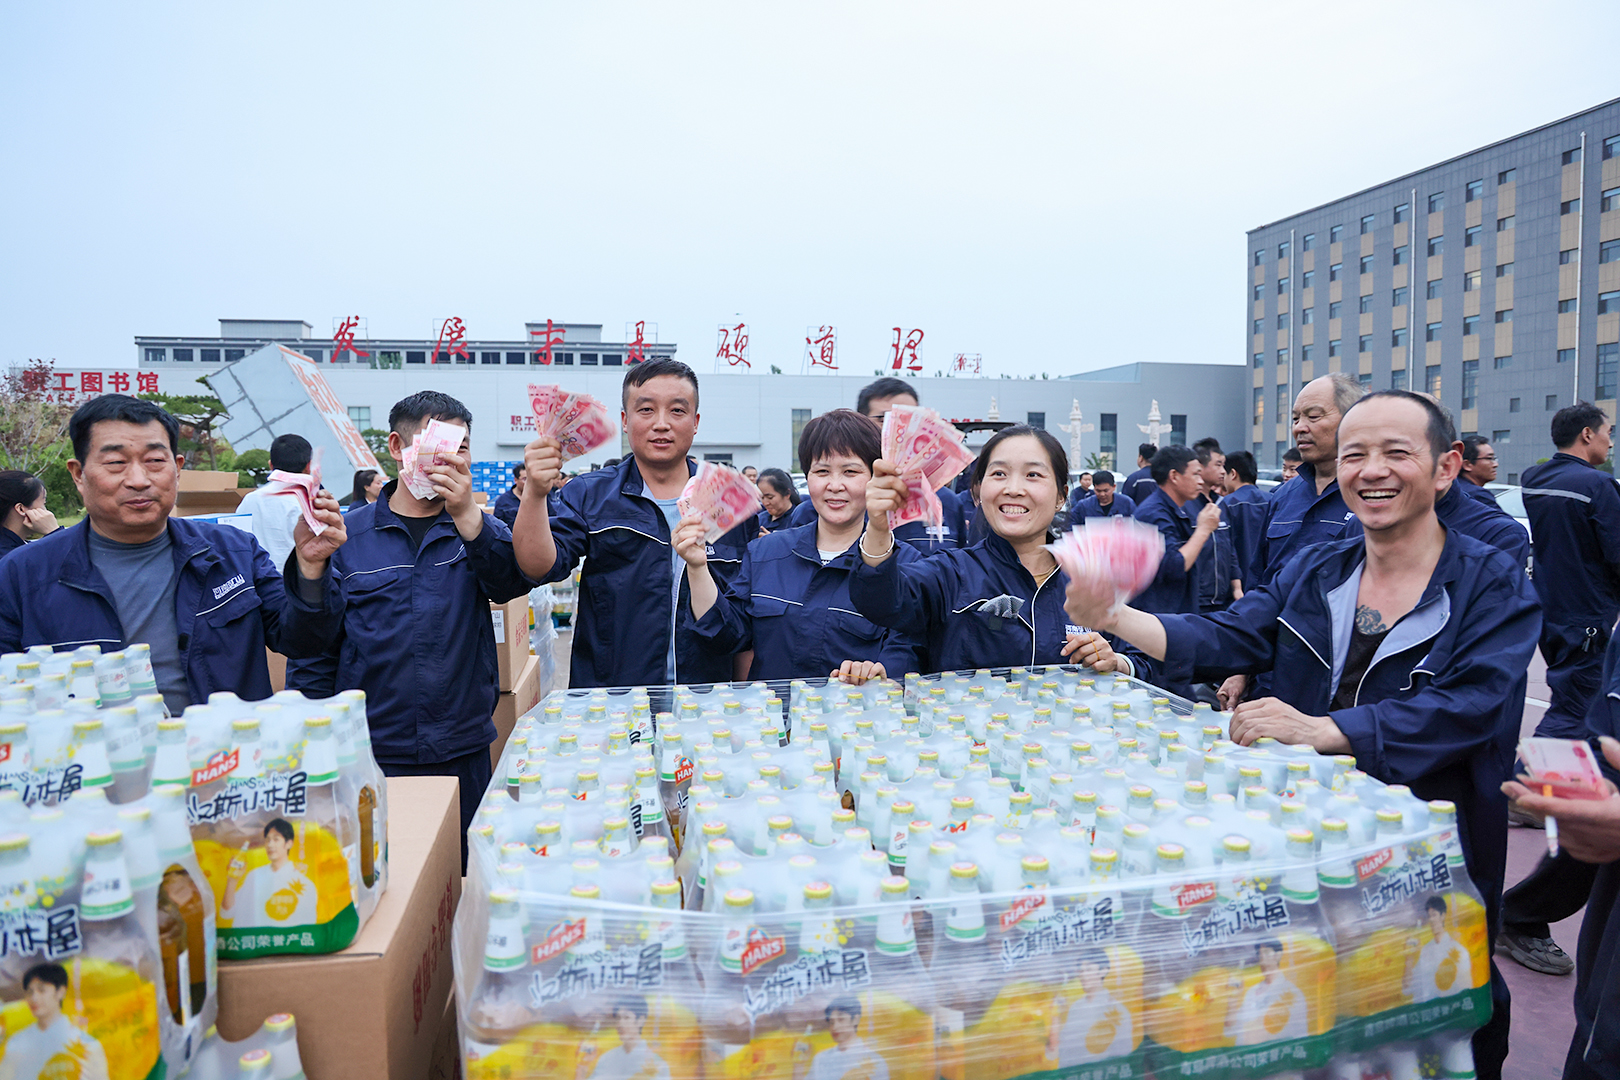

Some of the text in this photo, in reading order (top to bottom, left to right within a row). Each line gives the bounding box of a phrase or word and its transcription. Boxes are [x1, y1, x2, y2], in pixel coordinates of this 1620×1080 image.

[331, 315, 924, 371] 发展才是硬道理
[196, 754, 237, 783] HANS
[677, 767, 694, 780] HAN
[0, 764, 84, 803] 小木屋
[187, 771, 308, 823] 汉斯小木屋
[1360, 849, 1391, 876] HANS
[1004, 895, 1043, 925] HANS
[1180, 886, 1213, 906] HANS
[537, 923, 582, 959] HANS
[743, 940, 782, 969] HANS
